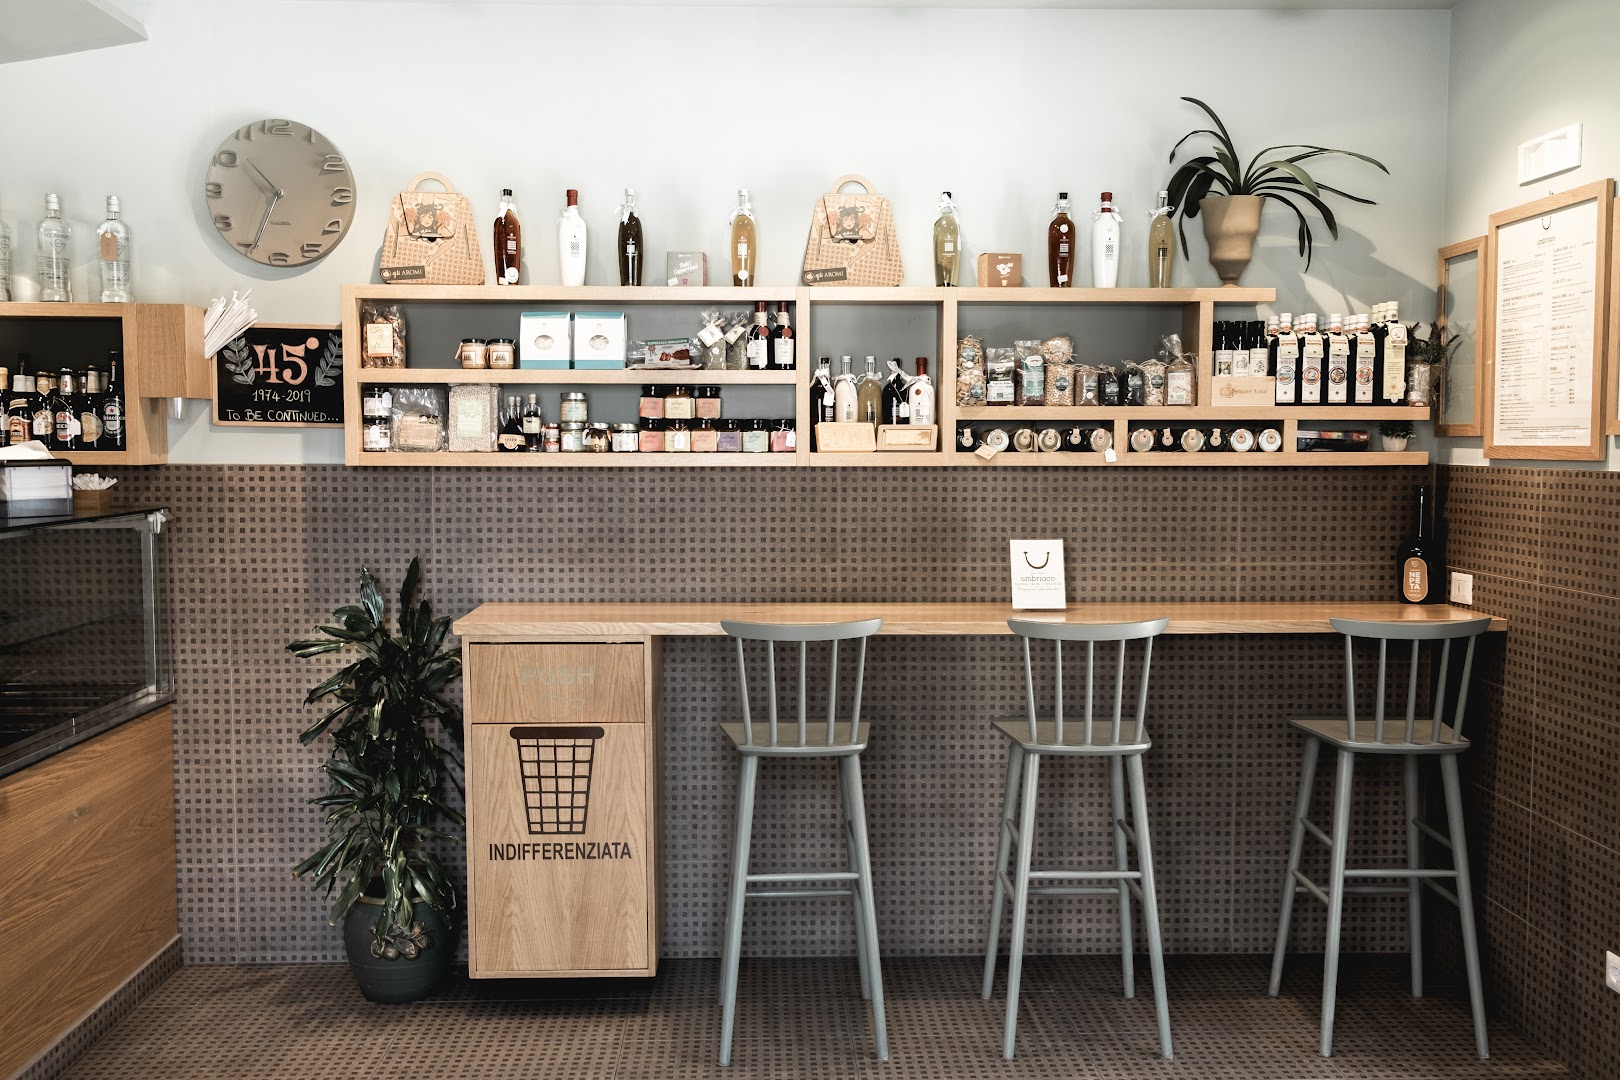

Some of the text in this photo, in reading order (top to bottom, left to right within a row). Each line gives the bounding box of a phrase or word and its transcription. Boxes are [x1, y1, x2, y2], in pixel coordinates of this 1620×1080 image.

[236, 125, 254, 142] 11
[261, 119, 294, 136] 12
[212, 150, 239, 168] 10
[323, 154, 345, 172] 2
[206, 182, 223, 199] 9
[331, 187, 352, 203] 3
[215, 215, 232, 232] 8
[324, 219, 342, 233] 4
[300, 243, 323, 259] 5
[252, 389, 311, 403] 1974-2019
[244, 408, 264, 421] BE
[520, 664, 596, 686] PUSH
[489, 842, 632, 861] INDIFFERENZIATA
